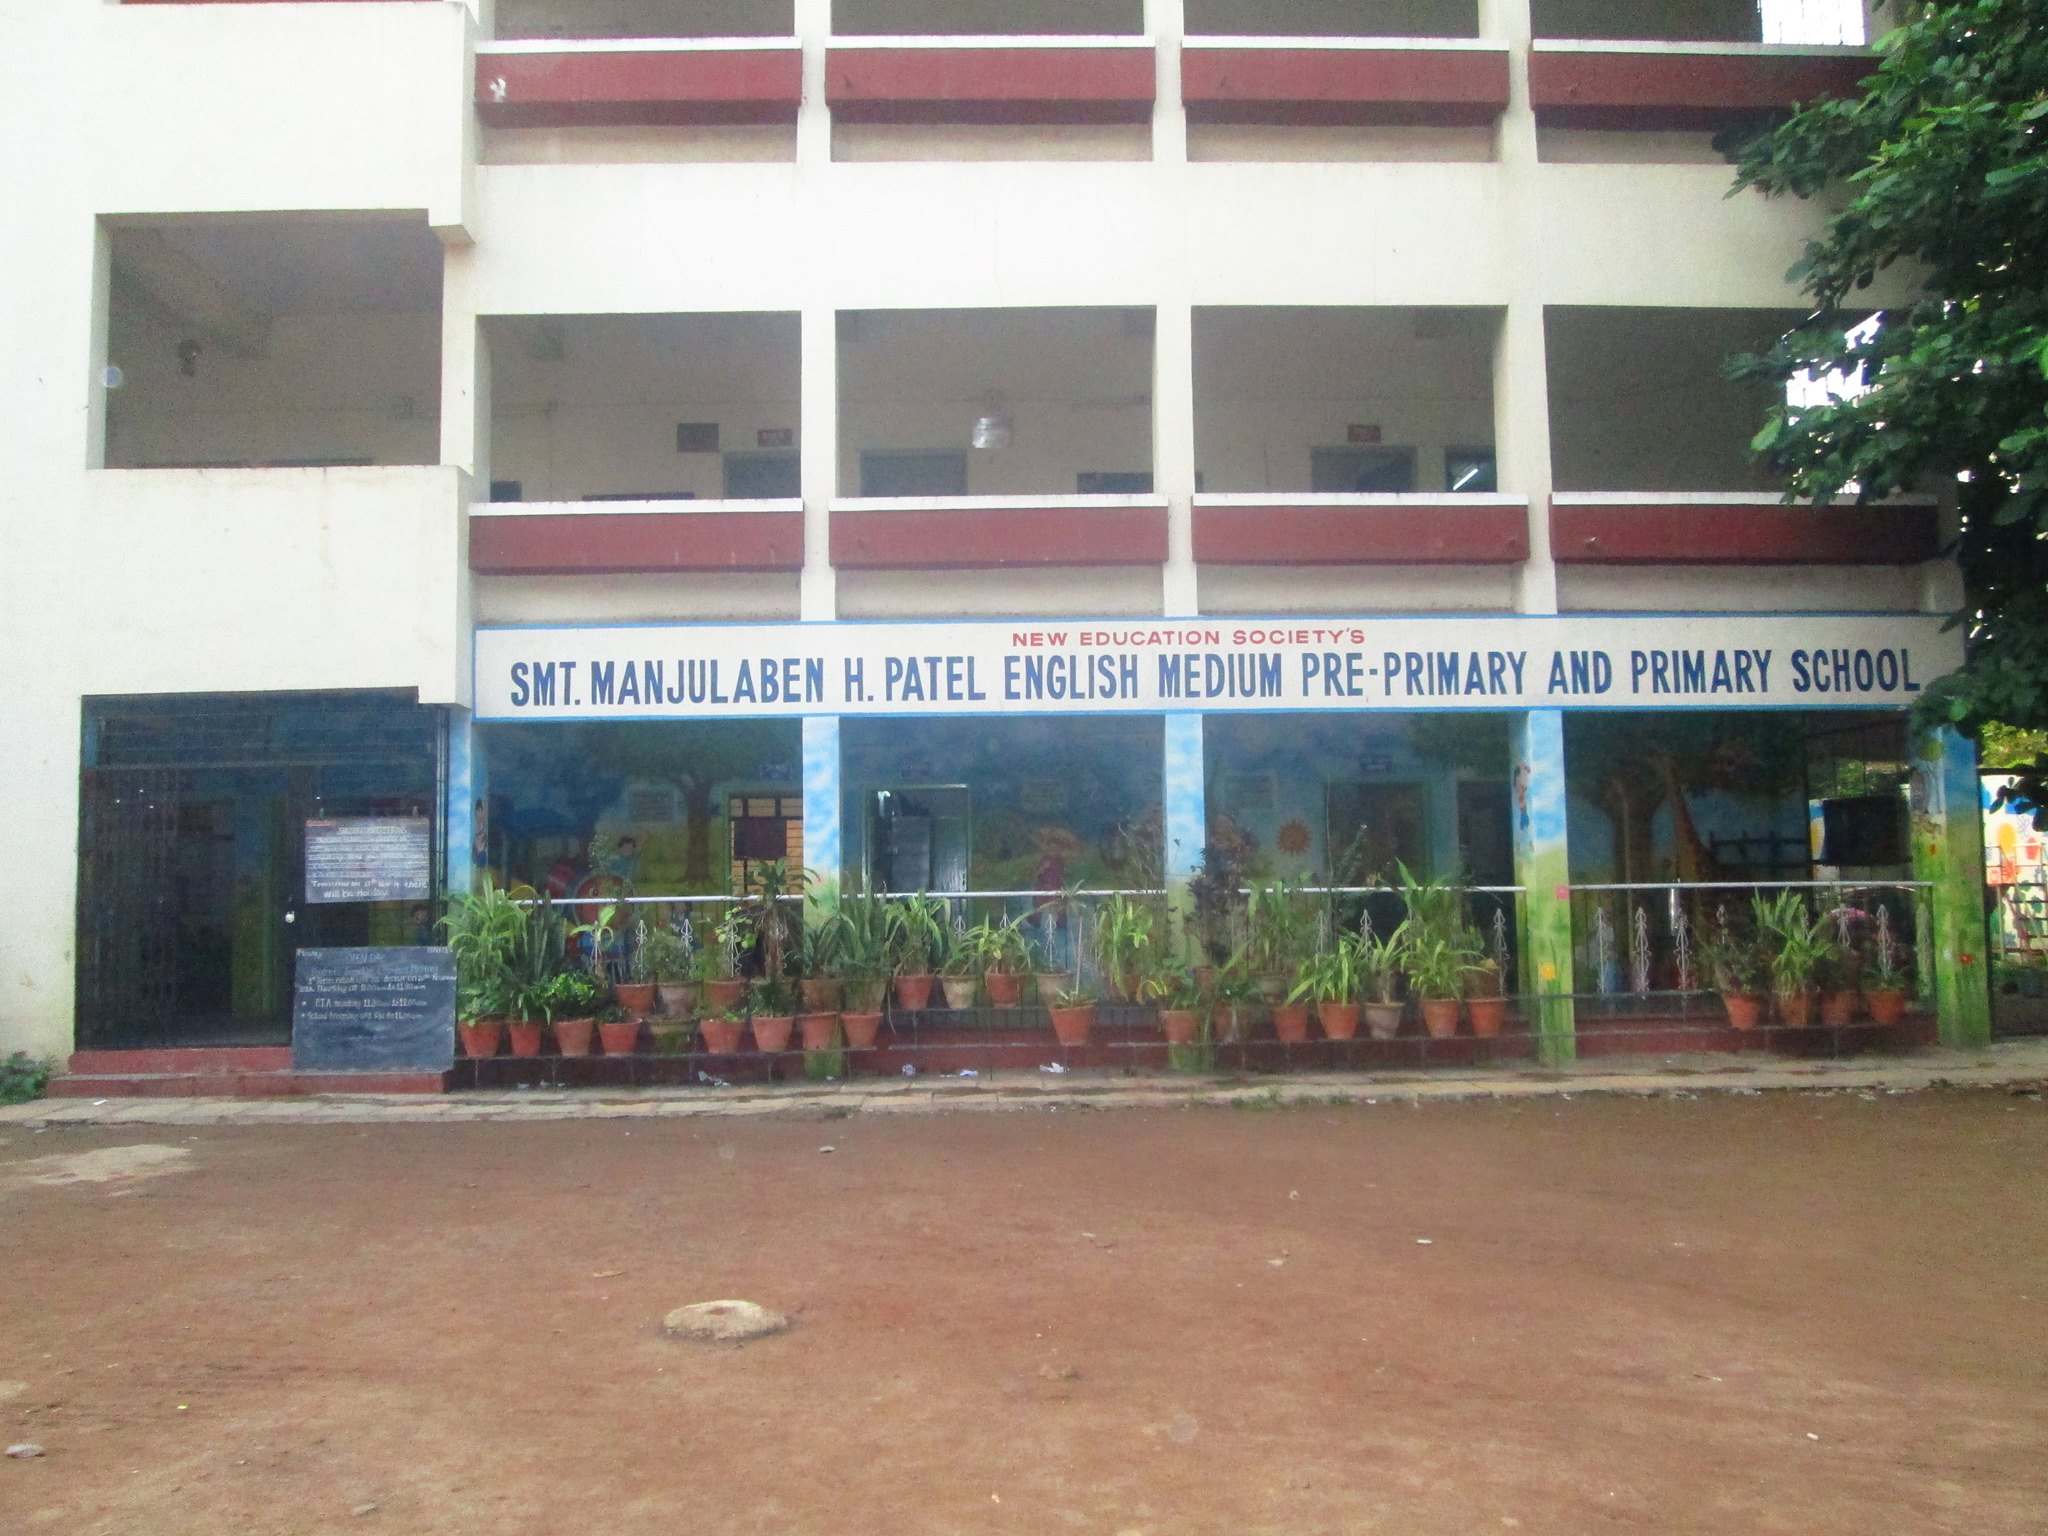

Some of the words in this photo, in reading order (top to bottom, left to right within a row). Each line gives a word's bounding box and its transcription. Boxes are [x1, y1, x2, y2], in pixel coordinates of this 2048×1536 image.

[1012, 632, 1068, 647] NEW
[1080, 630, 1220, 646] EDUCATION
[1232, 628, 1365, 645] SOCIETY'S
[510, 661, 581, 706] SMT.
[591, 658, 824, 705] MANJULABEN
[845, 657, 874, 702] H.
[886, 656, 985, 702] PATEL
[1004, 654, 1138, 700] ENGLISH
[1158, 652, 1282, 698] MEDIUM
[1301, 651, 1527, 697] PRE-PRIMARY
[1547, 650, 1613, 695] AND
[1631, 649, 1772, 694] PRIMARY
[1791, 648, 1921, 692] SCHOOL
